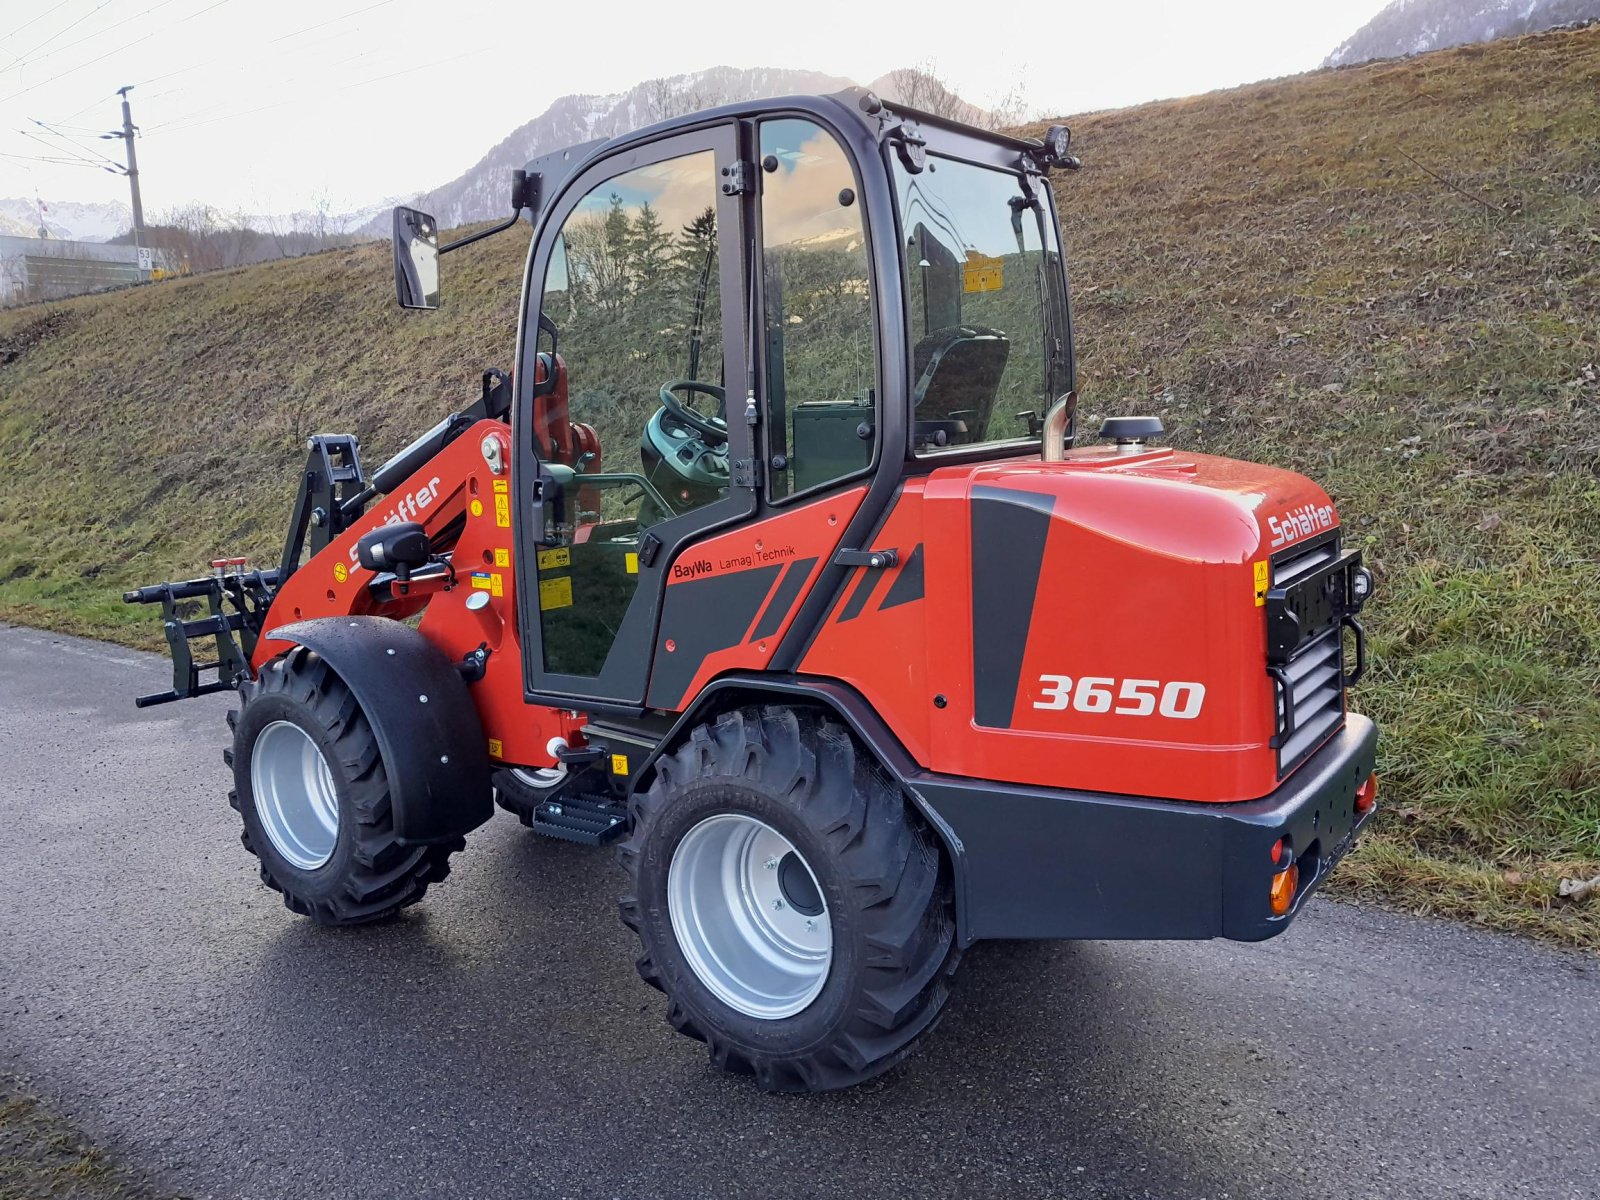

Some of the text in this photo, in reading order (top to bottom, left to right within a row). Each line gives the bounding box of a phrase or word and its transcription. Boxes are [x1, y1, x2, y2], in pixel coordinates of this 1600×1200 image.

[139, 249, 150, 259] 53
[143, 259, 149, 267] 3
[1267, 503, 1335, 548] Schäffer
[674, 560, 713, 578] BayWa
[1033, 673, 1206, 720] 3650
